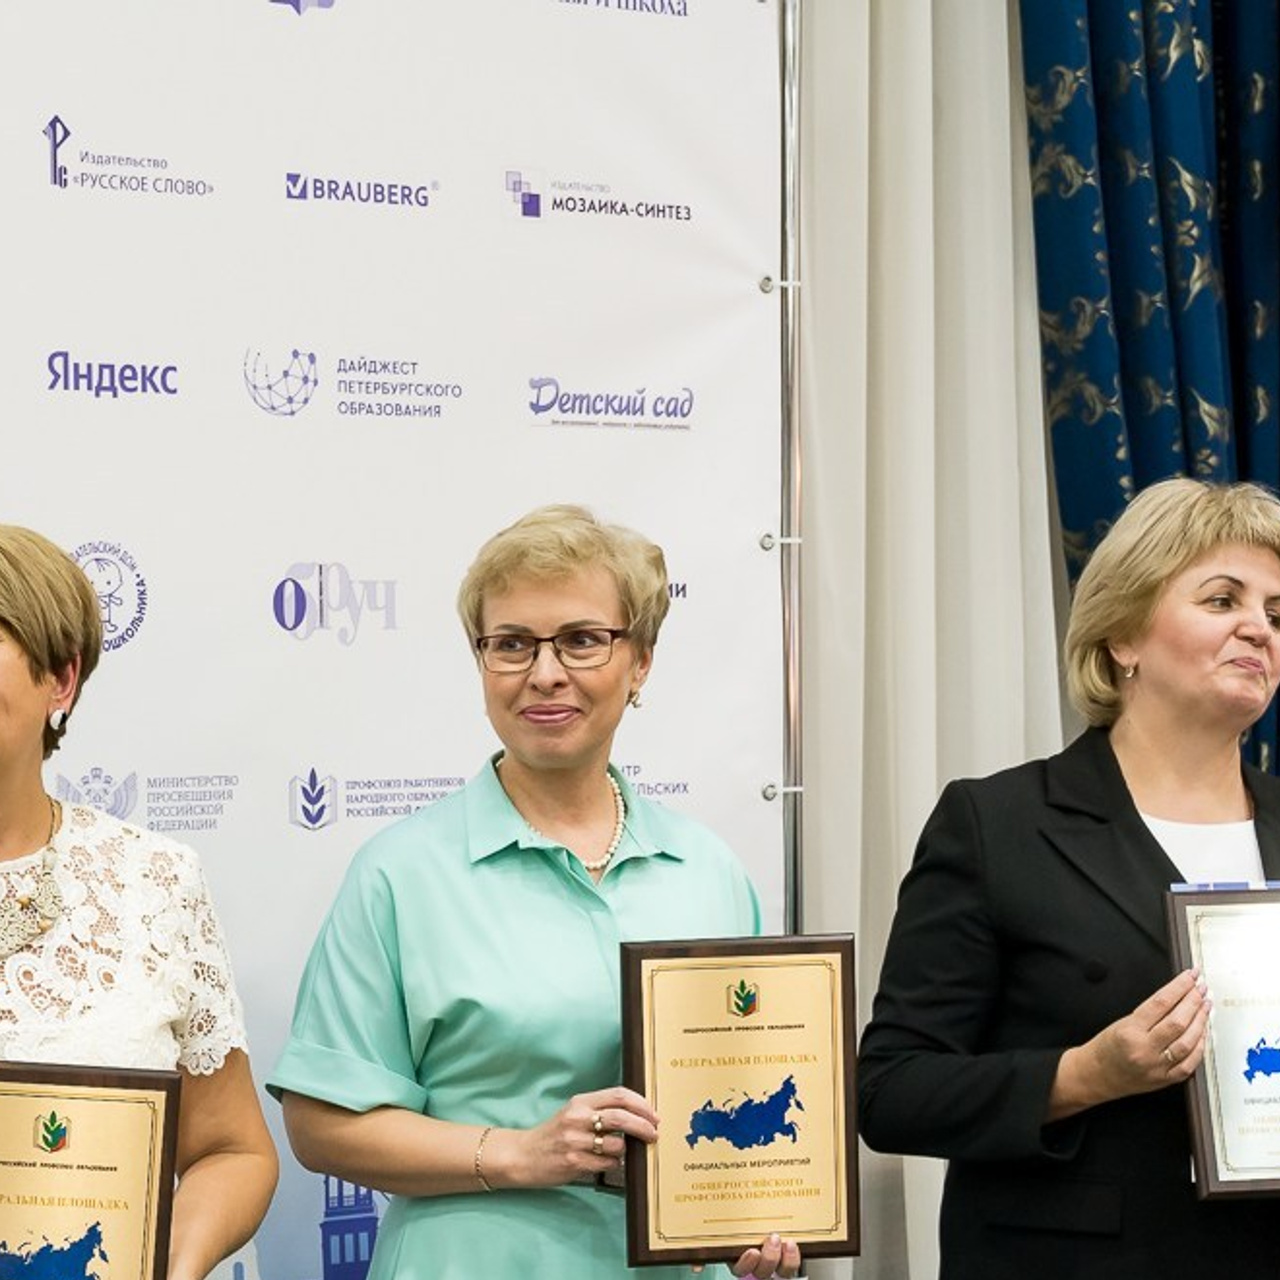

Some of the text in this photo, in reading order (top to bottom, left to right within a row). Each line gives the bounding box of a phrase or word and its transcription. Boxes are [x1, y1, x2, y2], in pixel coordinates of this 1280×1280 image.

[80, 151, 168, 169] Издательство
[73, 173, 214, 196] «РУССКОЕ СЛОВО»
[551, 197, 691, 220] МОЗАИКА-СИНТЕЗ
[337, 357, 418, 376] ДАЙДЖЕСТ
[47, 351, 178, 398] Яндекс
[337, 380, 462, 399] ПЕТЕРБУРГСКОГО
[529, 377, 694, 418] Детский сад
[337, 401, 442, 418] ОБРАЗОВАНИЯ
[147, 775, 239, 789] МИНИСТЕРСТВО
[345, 777, 466, 790] ПРОФСОЮЗ РАБОТНИКОВ
[631, 783, 689, 796] ЛЬСКИХ
[147, 789, 234, 804] ПРОСВЕЩЕНИЯ
[345, 793, 406, 804] НАРОДНОГО
[147, 803, 224, 818] РОССИЙСКОЙ
[345, 804, 412, 818] РОССИЙСКОЙ
[147, 818, 218, 832] ФЕДЕРАЦИИ
[670, 1053, 819, 1069] ФЕДЕРАЛЬНАЯ ПЛОЩАДКА
[684, 1157, 811, 1172] ОФИЦИАЛЬНЫХ МЕРОПРИЯТИЙ
[691, 1178, 803, 1191] ОБЩЕРОССИЙСКОГО
[674, 1187, 821, 1203] ПРОФСОЮЗА ОБРАЗОВАНИЯ
[56, 1196, 130, 1211] ПЛОЩАДКА
